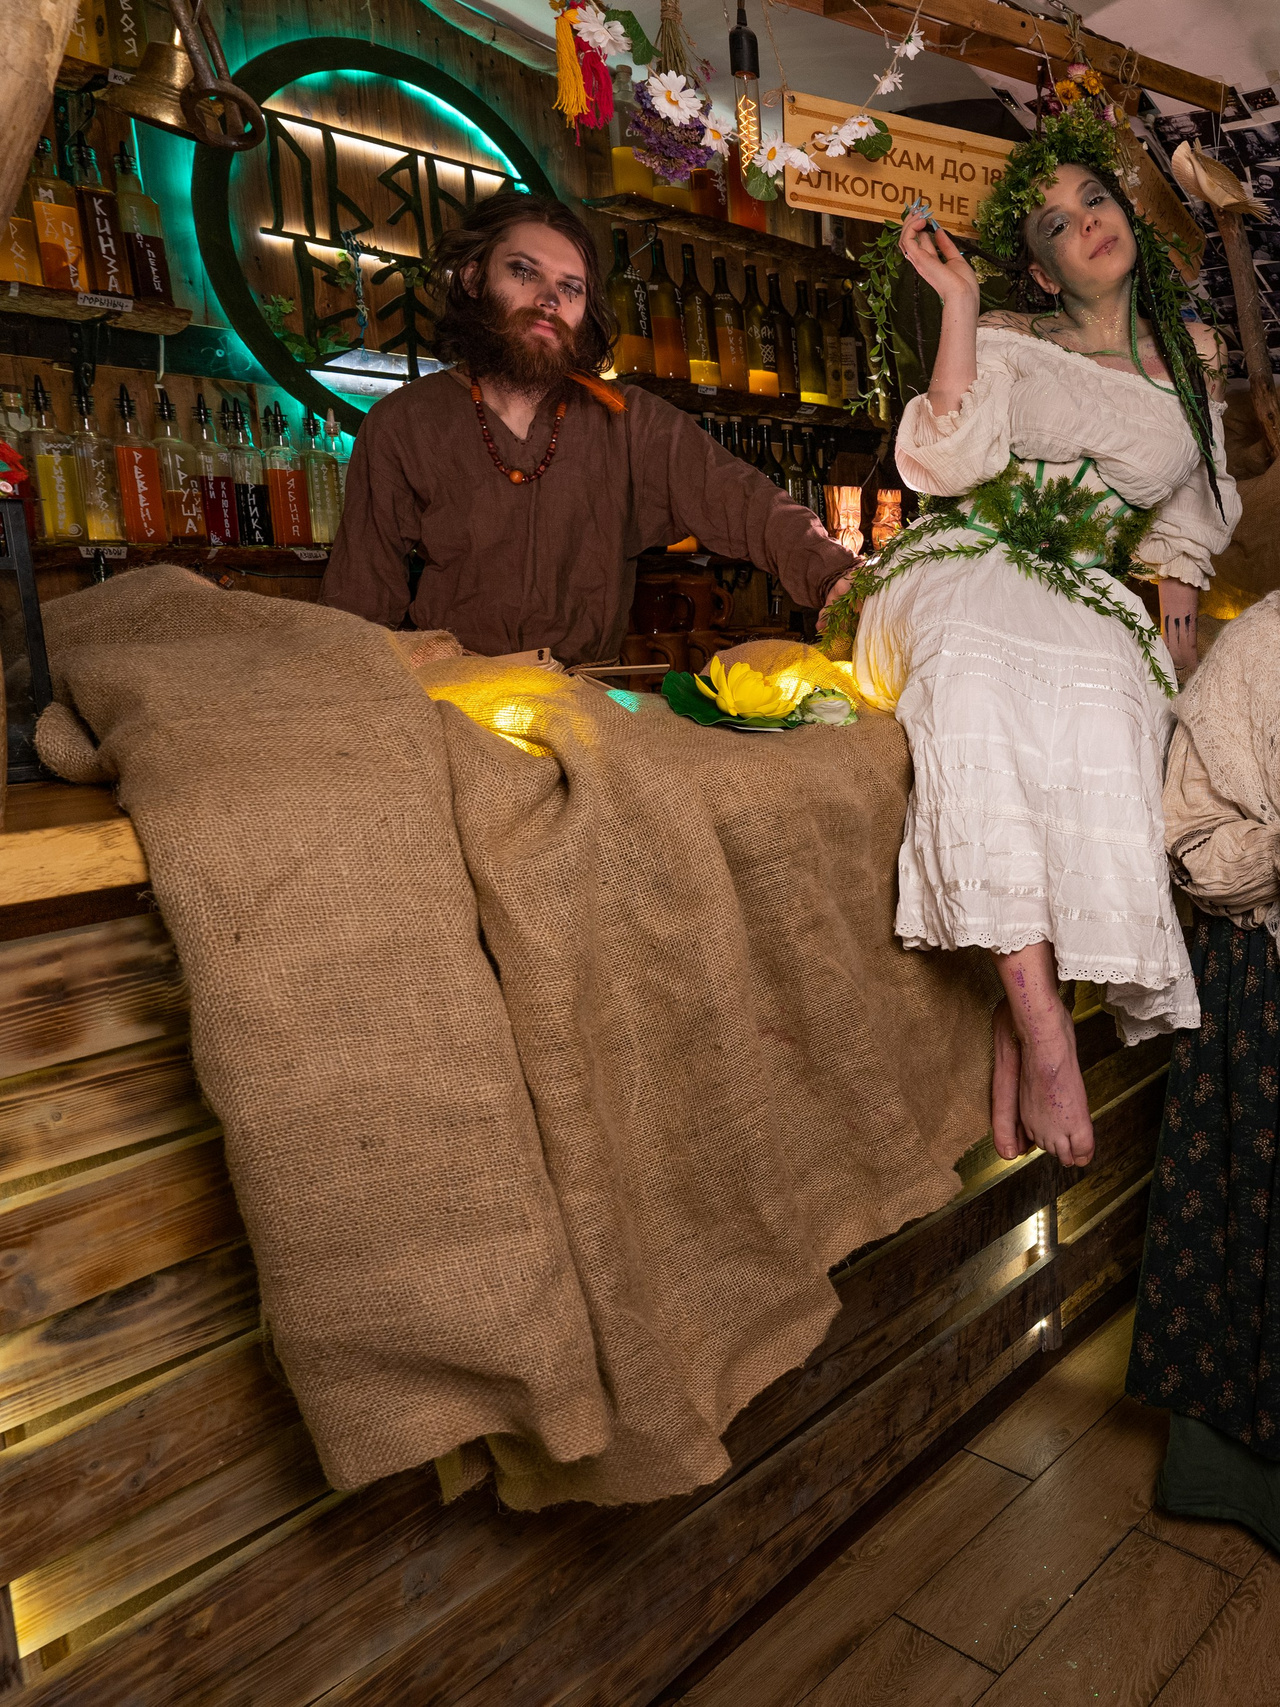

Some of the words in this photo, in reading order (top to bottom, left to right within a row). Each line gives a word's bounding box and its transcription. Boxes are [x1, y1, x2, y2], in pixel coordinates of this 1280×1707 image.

[795, 169, 932, 208] АЛКОГОЛЬ
[940, 193, 969, 216] НЕ
[811, 130, 934, 175] СКАМ
[941, 158, 976, 183] ДО
[93, 197, 121, 294] КИНЗА
[175, 454, 198, 534] ГРУША
[220, 481, 231, 538] КЛЮКВА
[245, 457, 264, 543] ЧЕРНИКА
[285, 461, 301, 537] РЯБИНА
